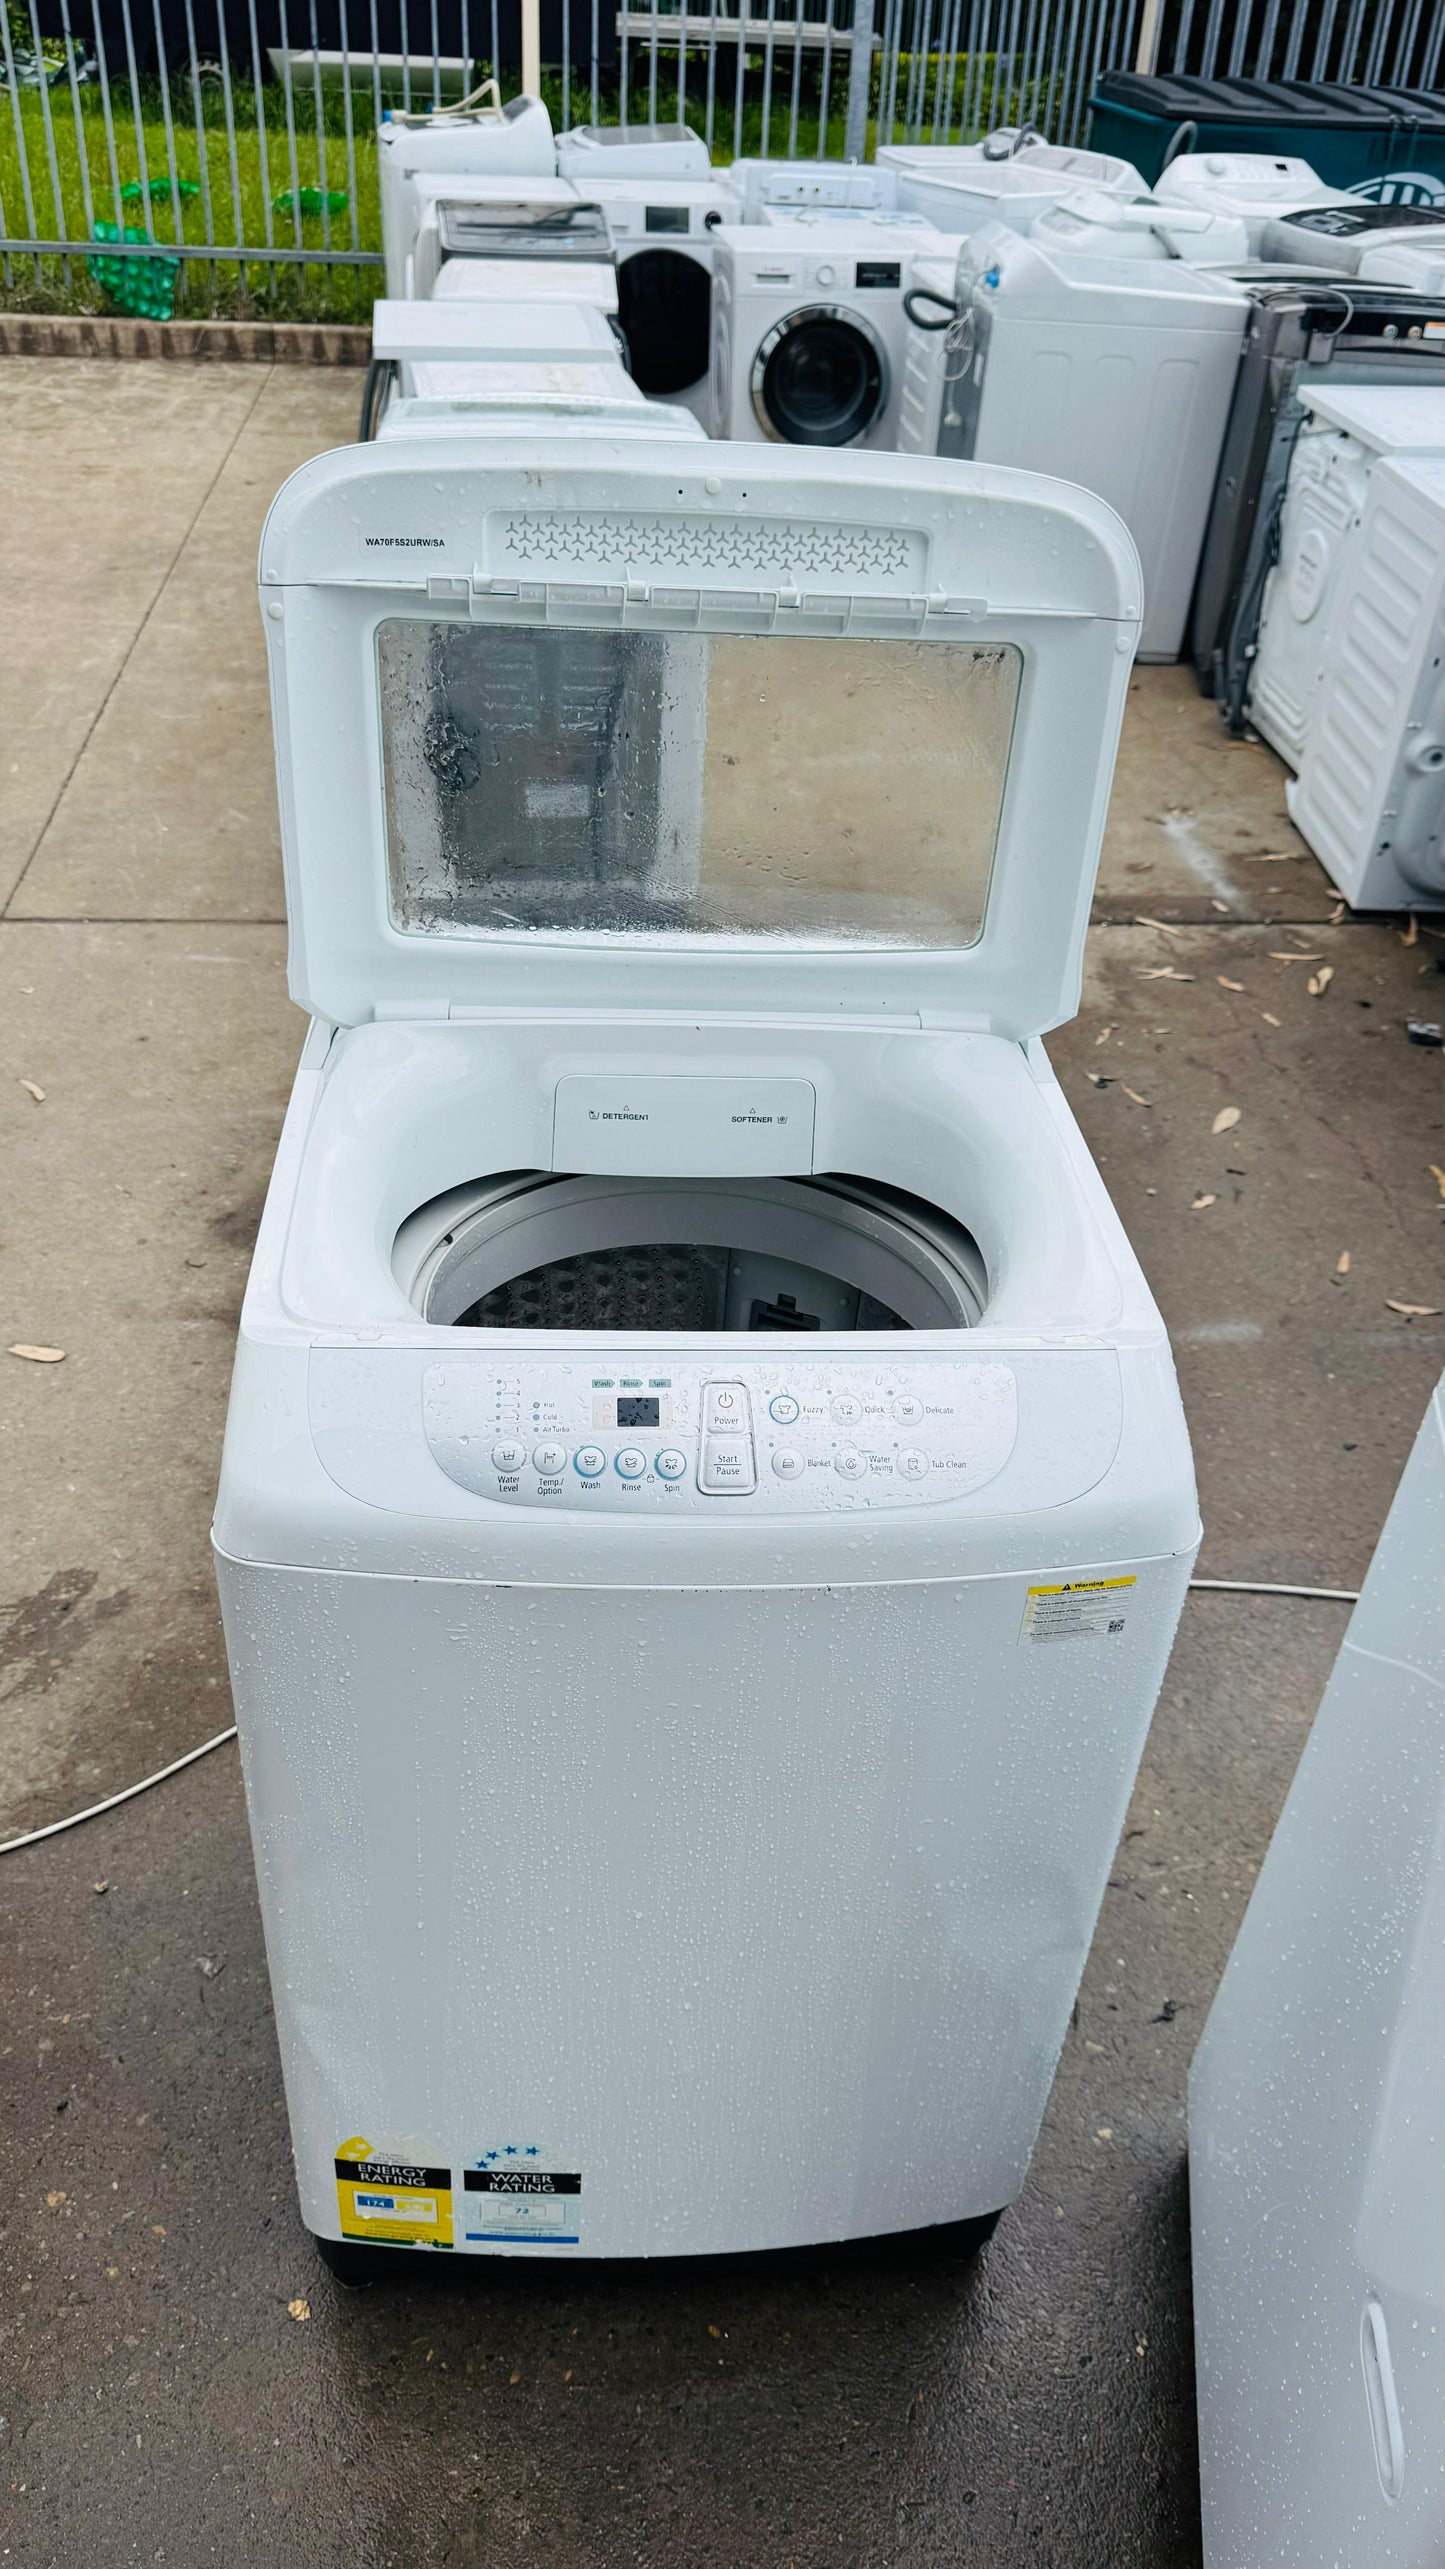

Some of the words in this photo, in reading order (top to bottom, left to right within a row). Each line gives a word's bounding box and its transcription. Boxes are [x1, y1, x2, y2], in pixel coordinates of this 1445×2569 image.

[365, 538, 445, 547] WA70F5S2URW/SA
[602, 1112, 649, 1121] DETERGENT
[731, 1115, 773, 1123] SOFTENER
[653, 1380, 666, 1388] Spin
[803, 1406, 824, 1415] Fuzzy
[864, 1405, 886, 1414] Quick
[925, 1406, 955, 1414] Delicate
[714, 1416, 739, 1425] Power
[717, 1454, 738, 1463] Start
[869, 1455, 890, 1463] Water
[807, 1459, 832, 1468] Blanket
[869, 1463, 894, 1473] Saving
[931, 1460, 945, 1468] Tub
[946, 1460, 967, 1468] Clean
[716, 1466, 740, 1475] Pause
[497, 1476, 520, 1484] Water
[539, 1478, 564, 1488] Temp./
[499, 1484, 519, 1492] Level
[580, 1481, 601, 1489] Wash
[621, 1483, 642, 1491] Rinse
[664, 1484, 680, 1493] Spin
[537, 1486, 562, 1495] Option
[1074, 1580, 1105, 1589] Warning
[358, 2163, 427, 2177] ENERGY
[360, 2173, 426, 2187] RATING
[491, 2173, 553, 2184] WATER
[489, 2182, 556, 2193] RATING
